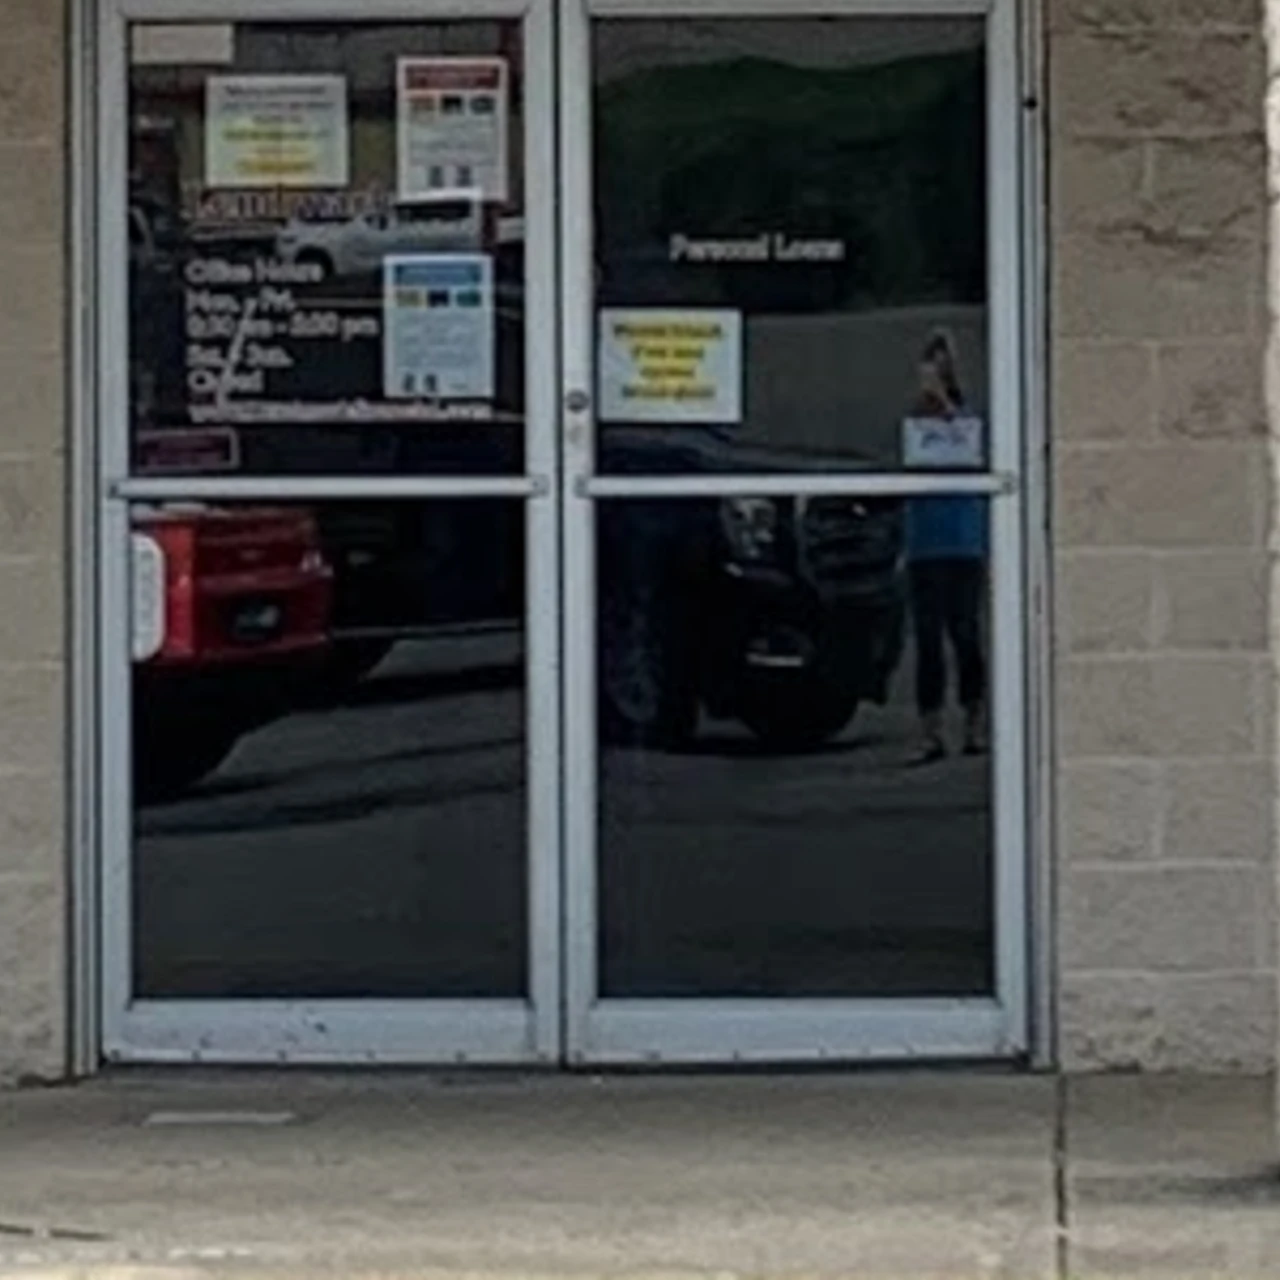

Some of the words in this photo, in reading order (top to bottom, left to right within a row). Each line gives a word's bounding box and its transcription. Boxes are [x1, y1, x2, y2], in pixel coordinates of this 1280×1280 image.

[670, 232, 769, 261] Personal
[775, 232, 846, 261] Loans
[184, 260, 253, 283] Office
[255, 256, 323, 283] Hours
[341, 317, 380, 342] pm
[187, 370, 264, 393] Clsed
